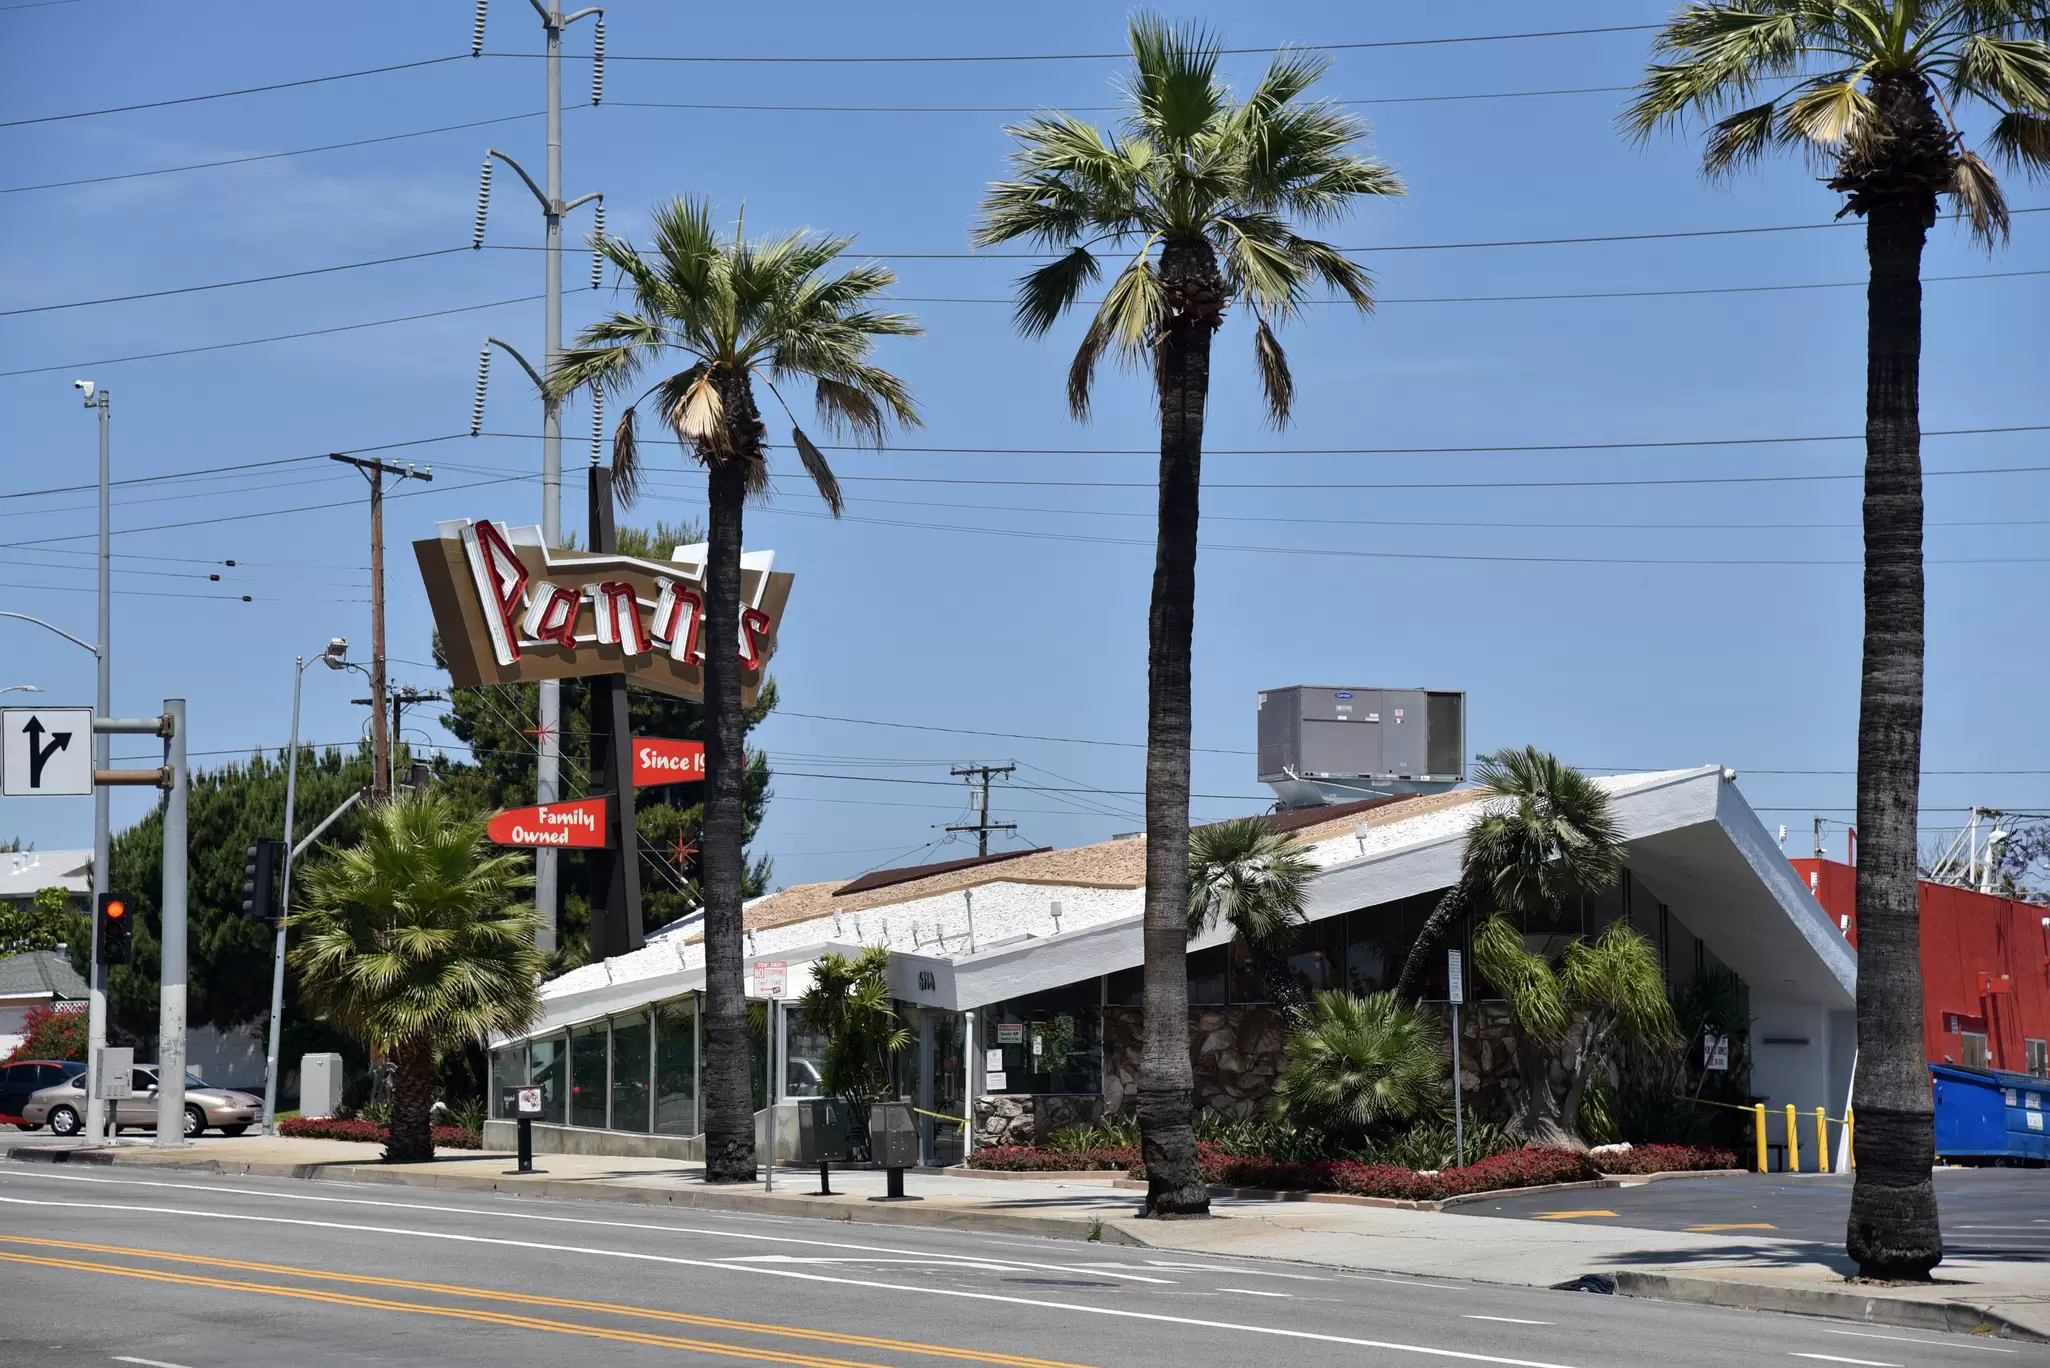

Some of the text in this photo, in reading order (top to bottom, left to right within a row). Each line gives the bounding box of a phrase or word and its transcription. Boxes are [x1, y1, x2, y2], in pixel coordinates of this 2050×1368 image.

[459, 519, 770, 670] Panns
[639, 747, 690, 771] Since
[538, 806, 595, 832] Family
[511, 825, 569, 844] Owned
[754, 968, 764, 978] NO
